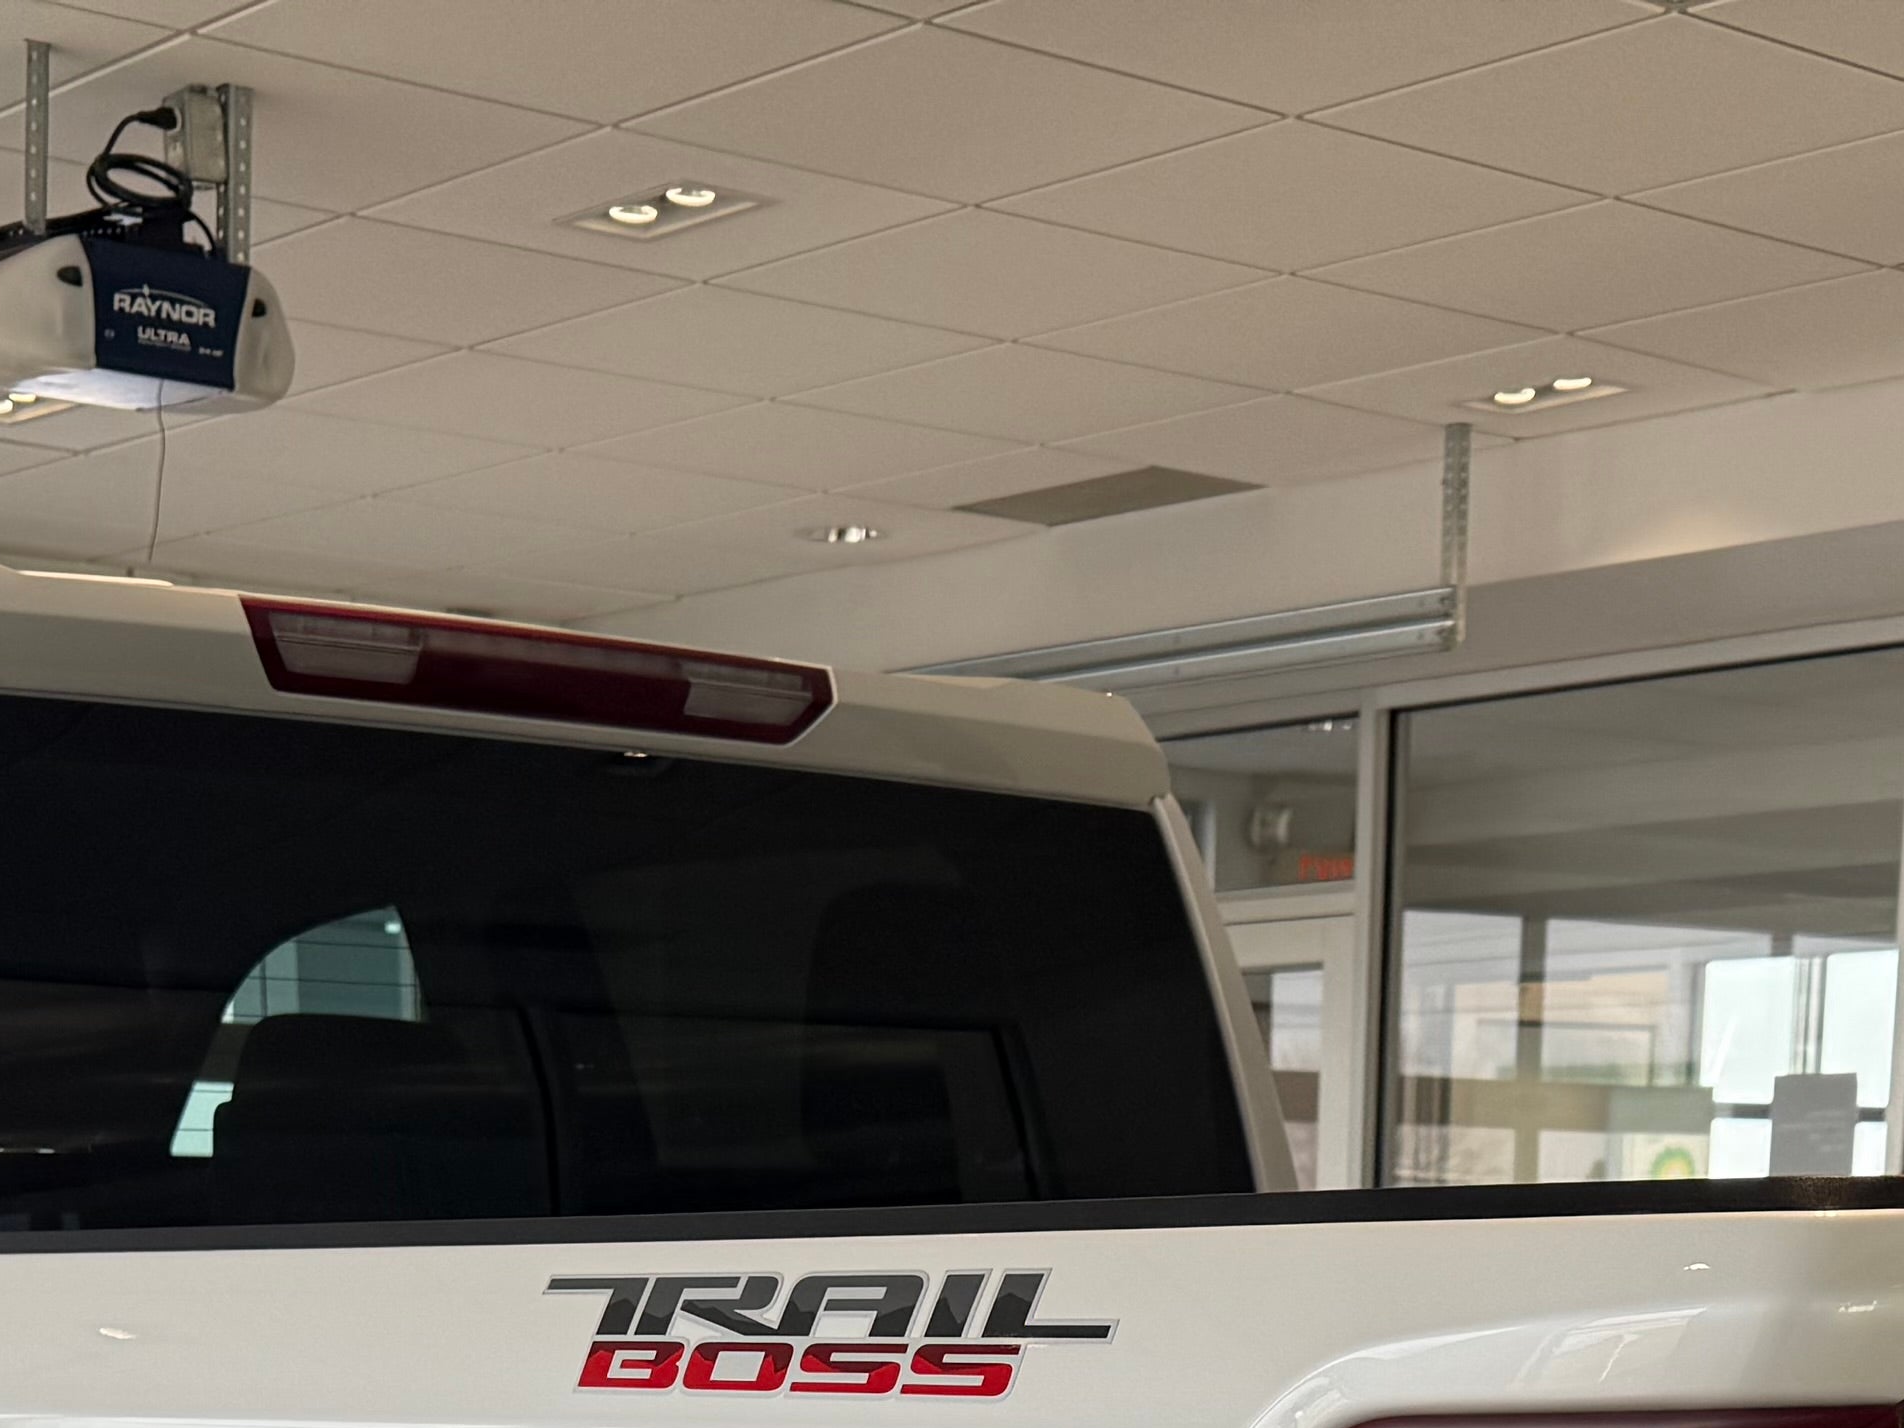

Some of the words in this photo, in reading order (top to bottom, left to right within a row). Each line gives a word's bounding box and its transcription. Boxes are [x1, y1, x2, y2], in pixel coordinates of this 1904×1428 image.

[113, 292, 216, 329] RAYNOR
[137, 325, 191, 346] ULTRA
[544, 1269, 1116, 1340] TRAIL
[576, 1340, 1024, 1398] BOSS
